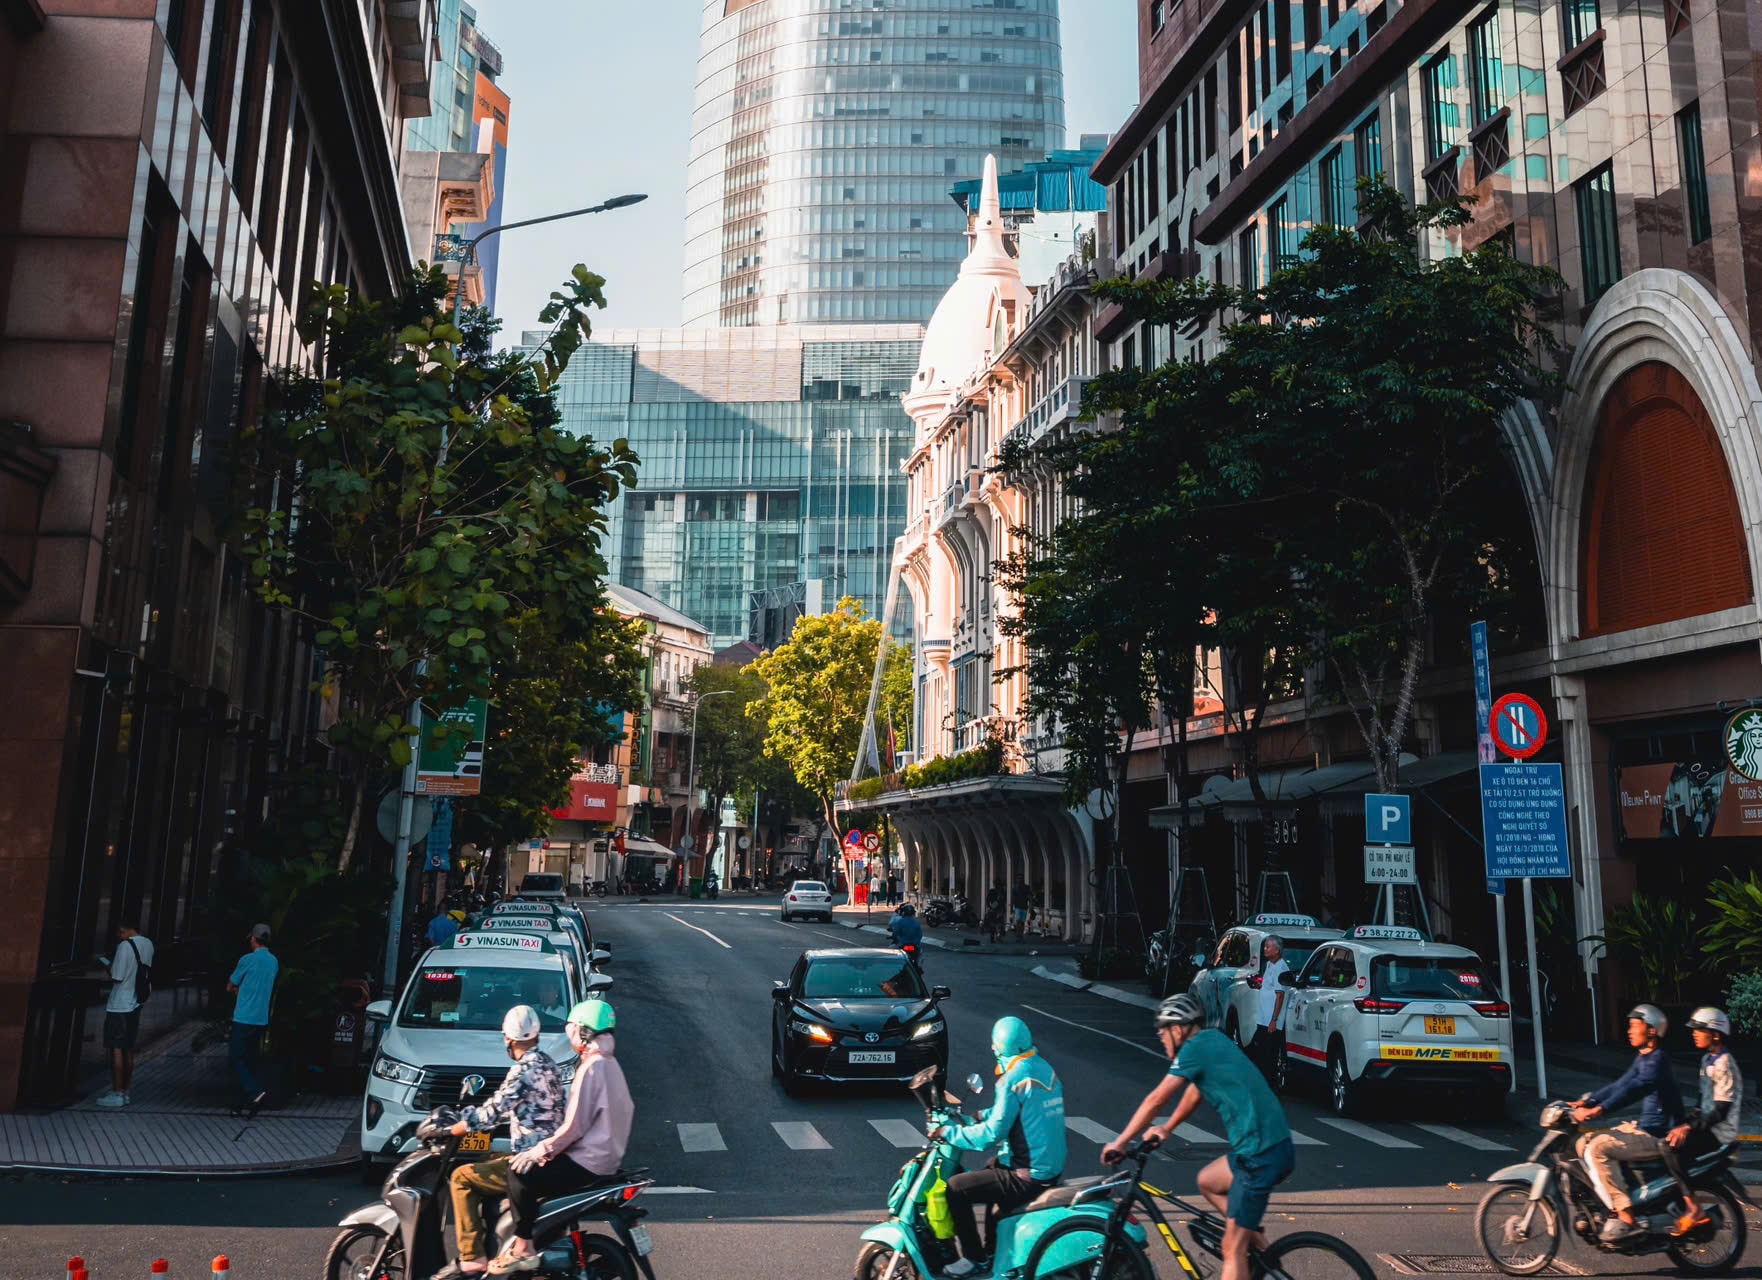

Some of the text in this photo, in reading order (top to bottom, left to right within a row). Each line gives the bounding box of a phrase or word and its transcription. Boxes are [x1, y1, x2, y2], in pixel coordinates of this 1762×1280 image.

[1382, 806, 1401, 831] P
[507, 903, 551, 912] VINASUN TAXI
[497, 919, 532, 927] VINASUN
[1396, 929, 1406, 938] 27
[1408, 930, 1418, 938] 27
[476, 937, 540, 948] VINASUN TAXI
[1401, 1049, 1413, 1057] LED
[1415, 1048, 1452, 1059] MPE
